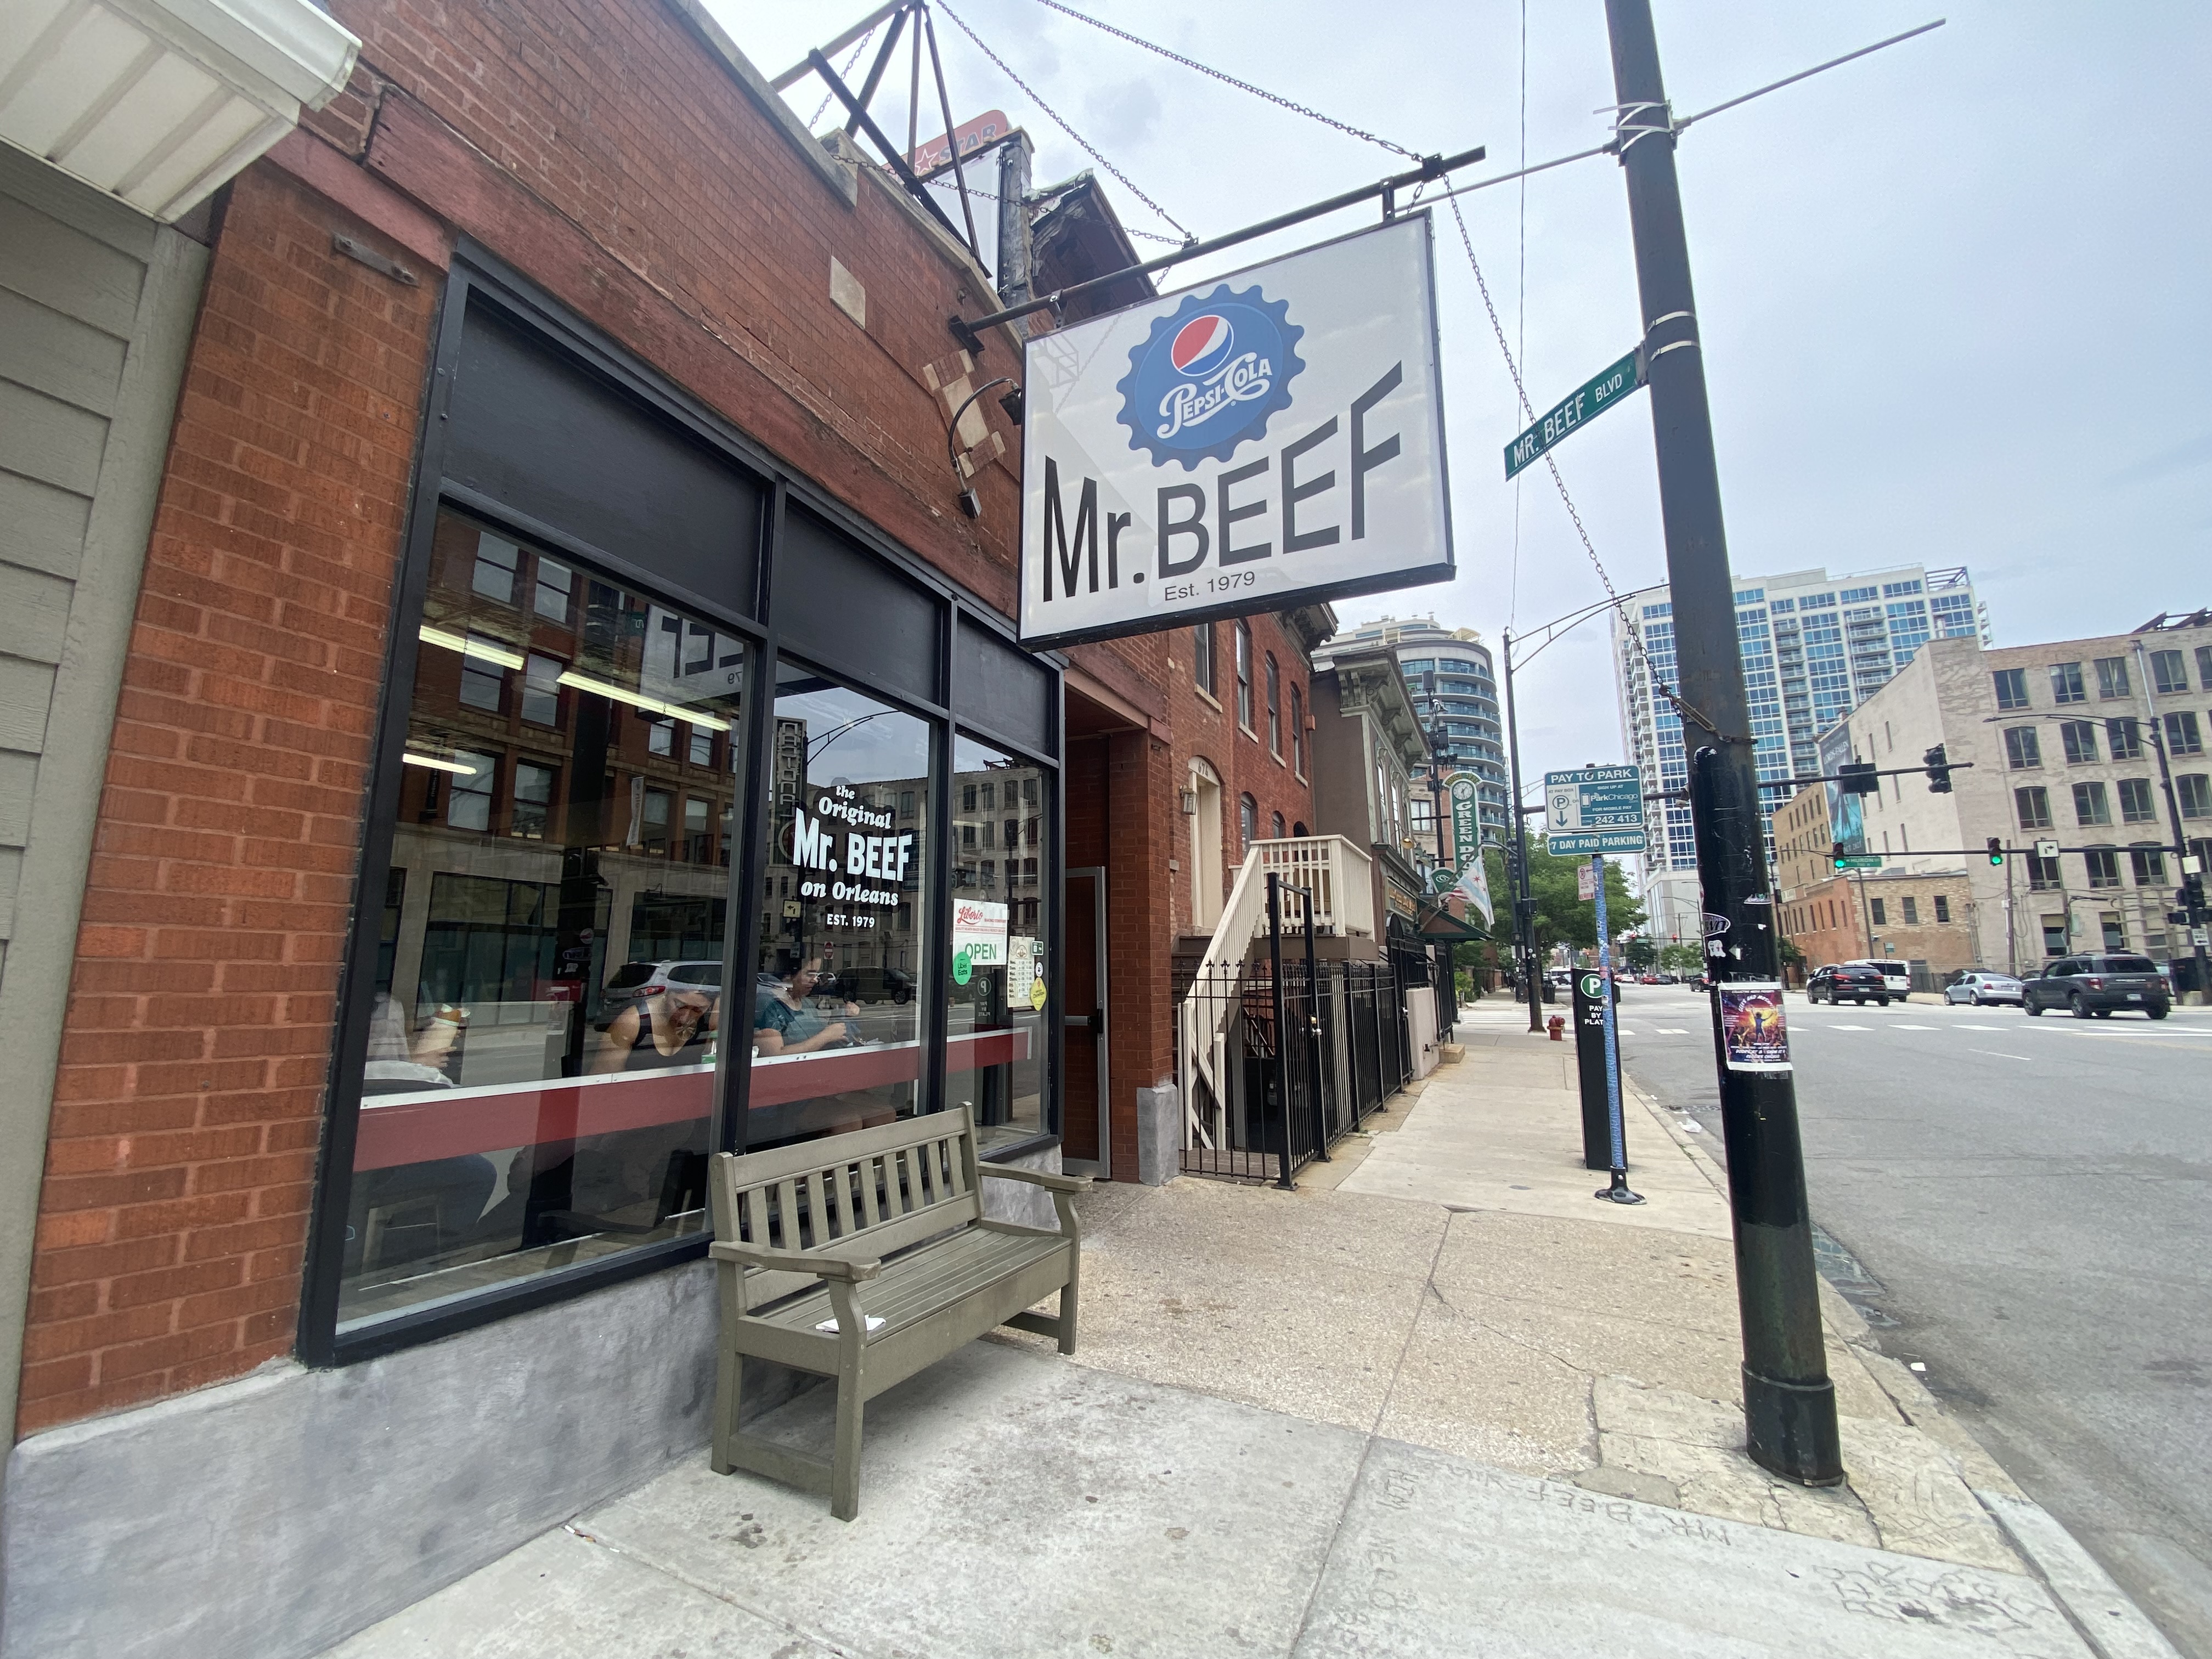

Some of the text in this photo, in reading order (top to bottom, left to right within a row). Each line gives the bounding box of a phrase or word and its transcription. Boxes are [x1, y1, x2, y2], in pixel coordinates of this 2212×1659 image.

[939, 123, 997, 162] STAR
[1513, 373, 1622, 467] MR. BEEF BLVD
[1043, 360, 1403, 603] Mr. BEEF
[1164, 571, 1256, 602] Est. 1979
[1551, 769, 1632, 783] PAY TO PARK
[836, 785, 855, 799] the
[1591, 793, 1638, 802] ParkChicago
[819, 797, 892, 829] Original
[1455, 800, 1474, 843] GREEN
[1595, 815, 1615, 825] 242
[1617, 814, 1638, 823] 413
[793, 807, 838, 872] Mr.
[847, 832, 912, 882] BEEF
[1551, 836, 1643, 850] 7 DAY PAID PARKING
[800, 881, 899, 906] on Orleans
[826, 913, 875, 928] EST. 1979
[957, 906, 984, 925] Liborio
[965, 943, 997, 960] OPEN
